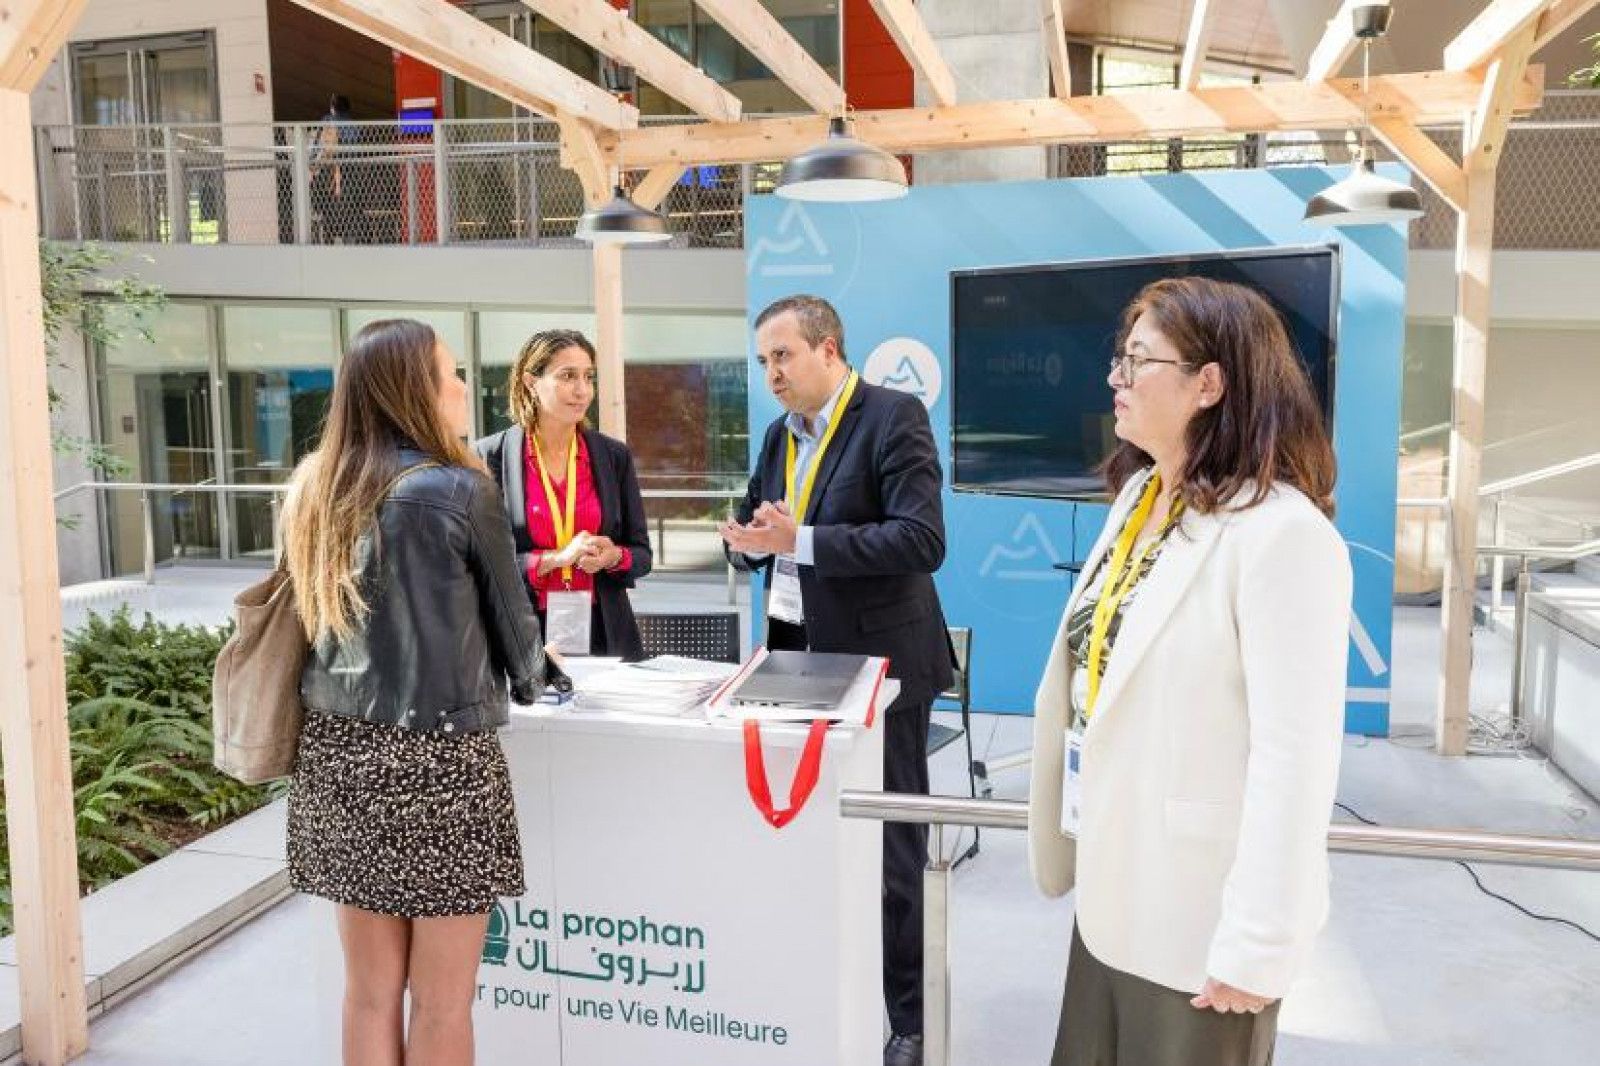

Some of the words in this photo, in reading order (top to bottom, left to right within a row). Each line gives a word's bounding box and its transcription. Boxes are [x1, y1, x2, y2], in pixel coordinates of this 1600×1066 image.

[515, 900, 548, 930] La
[562, 912, 705, 950] prophan
[494, 987, 551, 1011] pour
[567, 997, 614, 1020] une
[618, 999, 658, 1026] Vie
[665, 1005, 788, 1045] Meilleure
